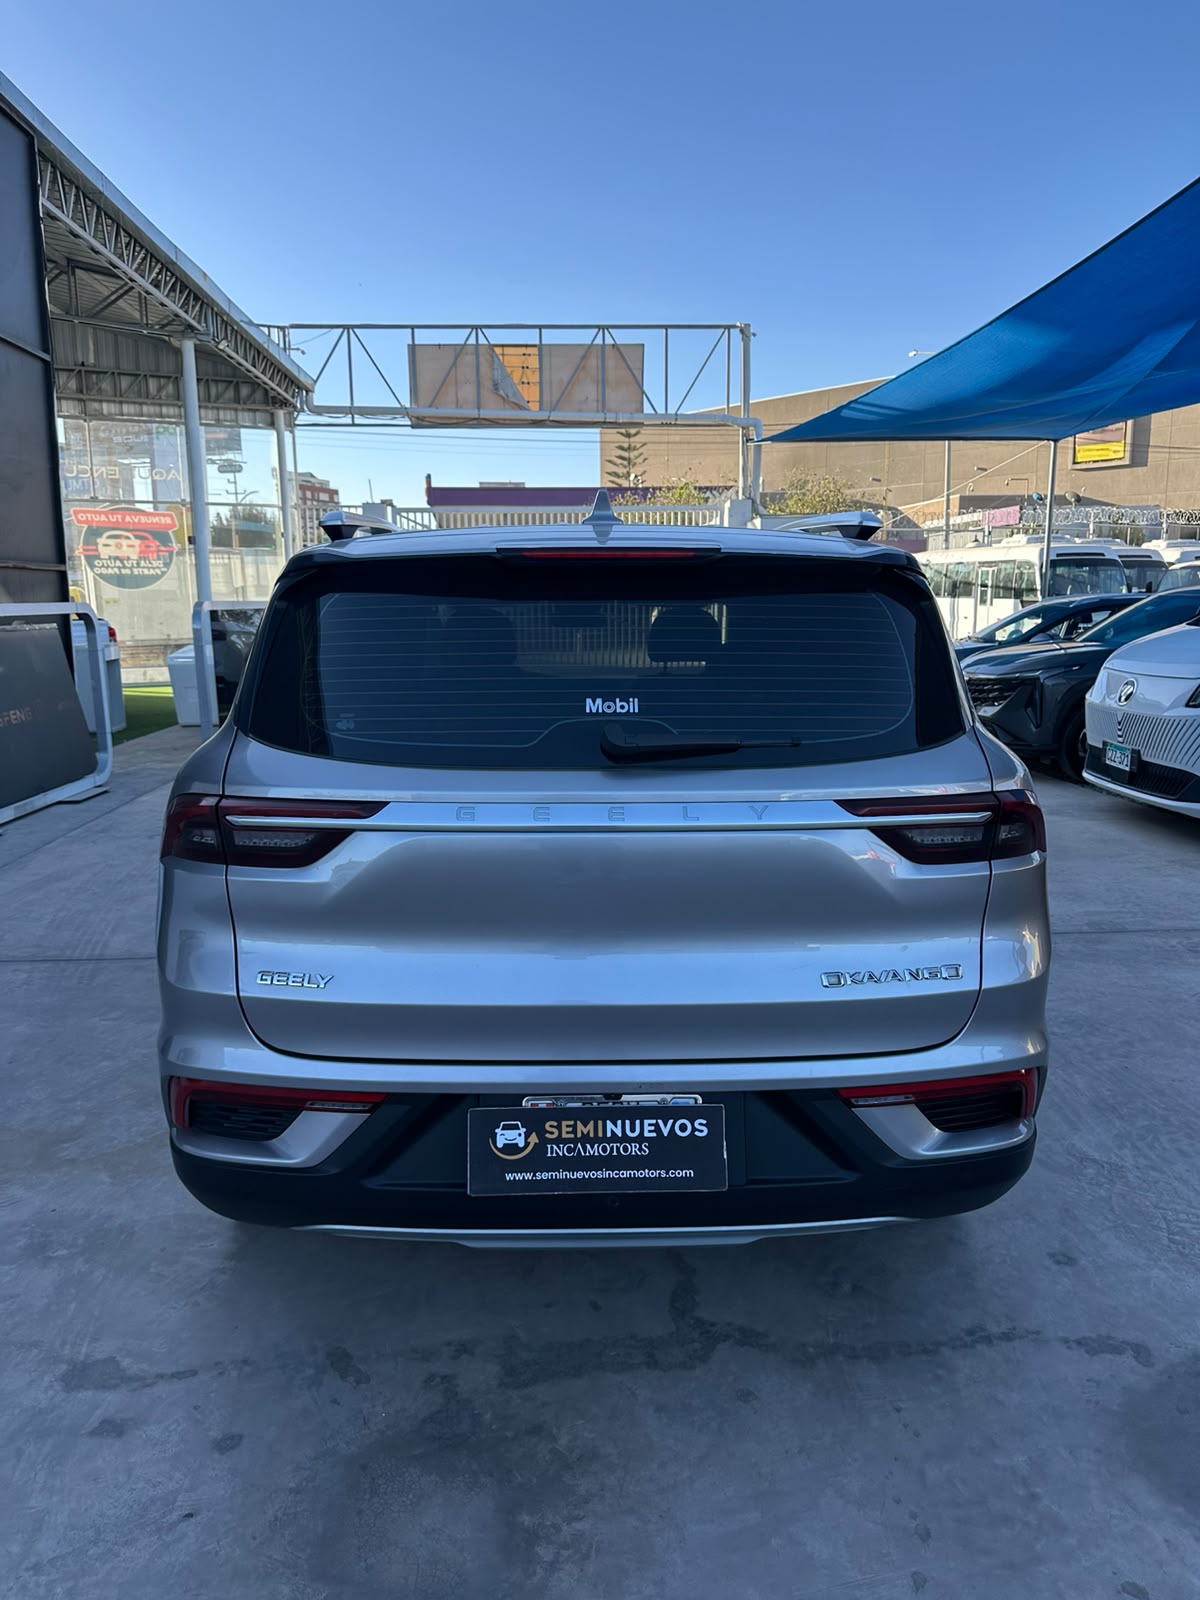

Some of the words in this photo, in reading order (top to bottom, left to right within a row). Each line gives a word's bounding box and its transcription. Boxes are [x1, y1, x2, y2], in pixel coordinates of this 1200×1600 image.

[585, 697, 639, 714] Mobil
[455, 804, 769, 822] GEELY
[256, 970, 335, 989] GEELY
[544, 1118, 709, 1139] SEMINUEVOS
[546, 1142, 649, 1158] INCAMOTORS
[505, 1168, 694, 1182] www.seminuevosincamotors.com
